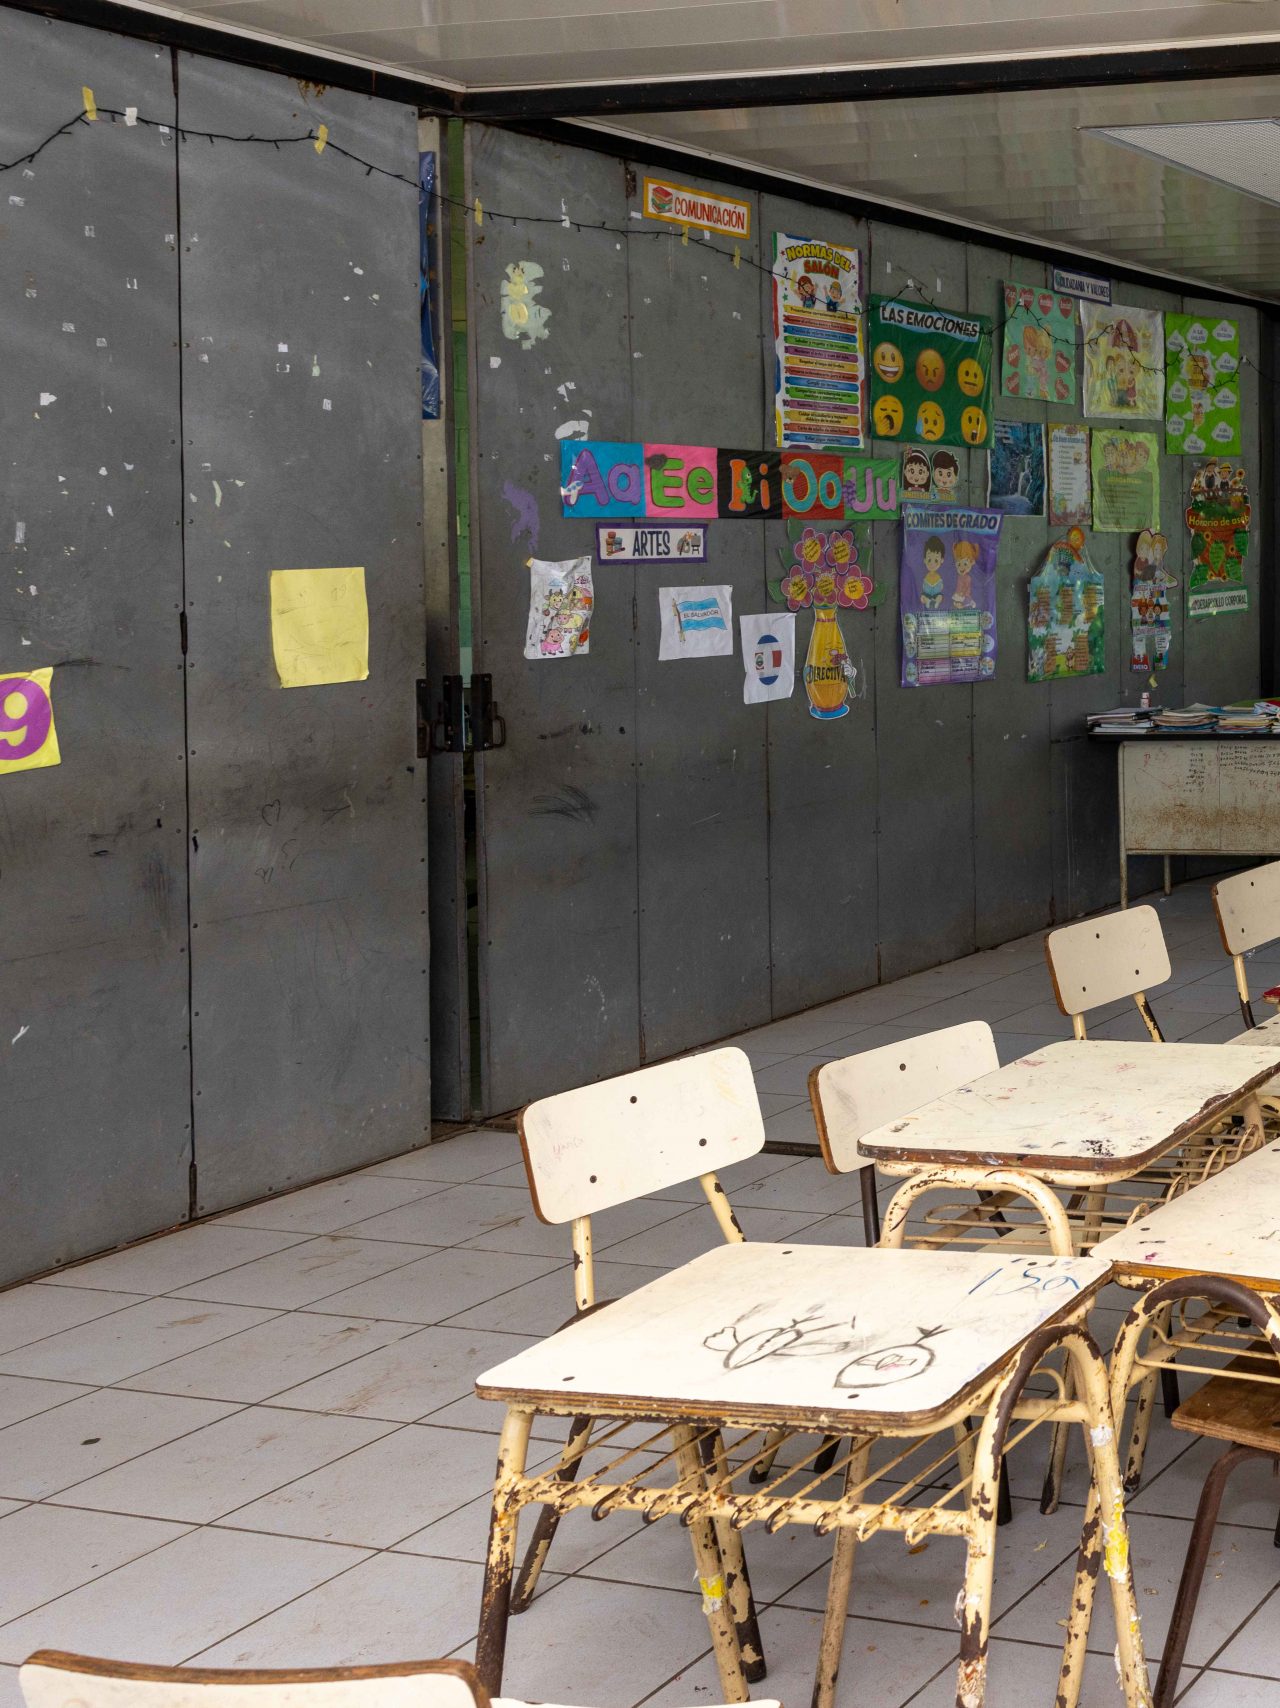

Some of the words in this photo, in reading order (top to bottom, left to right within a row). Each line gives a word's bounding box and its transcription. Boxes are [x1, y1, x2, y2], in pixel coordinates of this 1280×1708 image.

[674, 196, 745, 230] COMUNICACIÓN
[785, 243, 834, 262] NORMAS
[833, 251, 852, 273] DEL
[803, 259, 840, 280] SALÓN
[881, 305, 905, 322] LAS
[906, 311, 979, 338] EMOCIONES
[650, 457, 714, 509] Ee
[906, 512, 945, 529] COMITES
[945, 513, 958, 528] DE
[958, 513, 998, 530] GRADO
[1188, 515, 1219, 527] Horario
[1220, 516, 1230, 526] de
[632, 530, 671, 556] ARTES
[691, 609, 719, 618] SALVADOR
[808, 664, 847, 684] DIRECTIVA
[0, 678, 51, 760] 9
